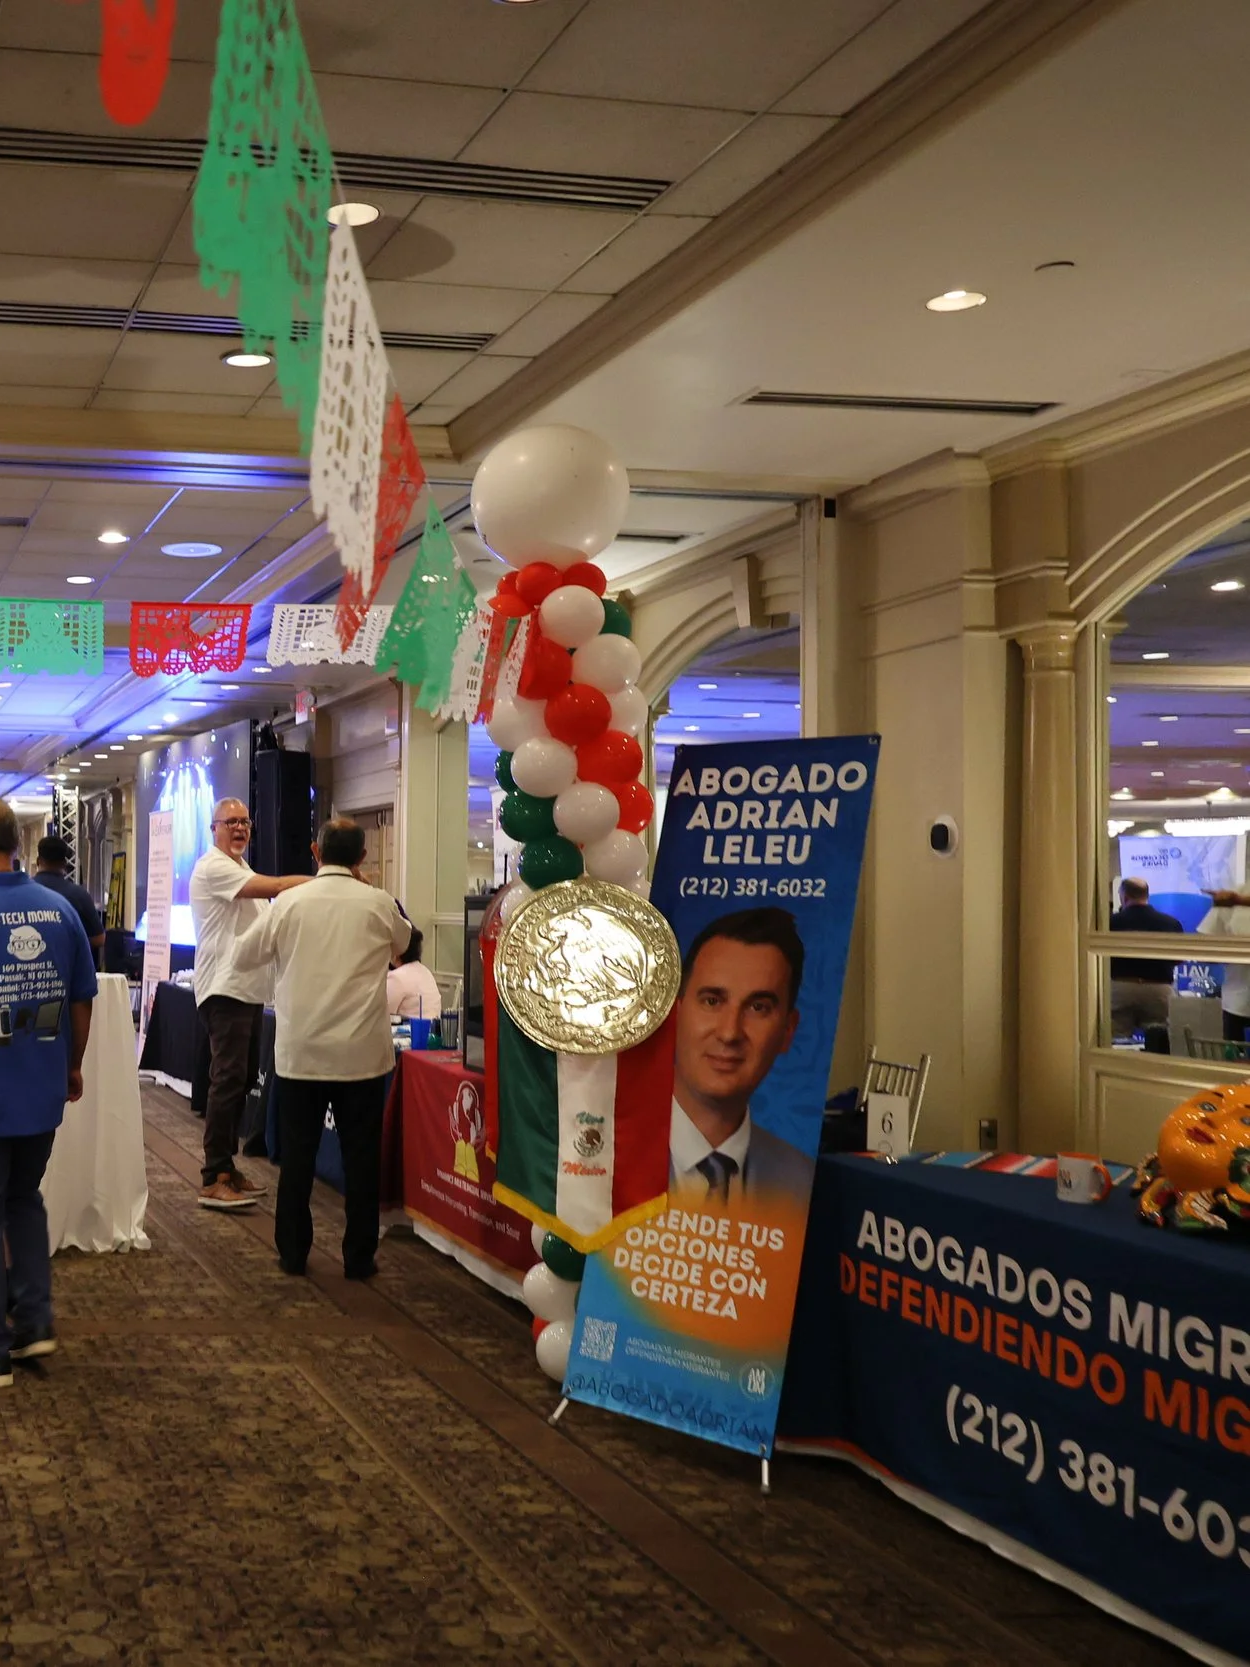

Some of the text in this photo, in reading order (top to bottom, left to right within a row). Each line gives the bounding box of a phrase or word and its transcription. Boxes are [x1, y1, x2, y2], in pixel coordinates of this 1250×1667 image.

[673, 760, 868, 797] ABOGADO
[686, 798, 839, 830] ADRIAN
[703, 834, 812, 865] LELEU
[679, 877, 826, 898] (212) 381-6032
[0, 911, 25, 924] TECH
[881, 1110, 893, 1136] 6
[625, 1226, 761, 1274] OPCIONES,
[738, 1221, 784, 1251] TUS
[613, 1246, 768, 1300] DECIDE CON
[856, 1209, 1092, 1331] ABOGADOS
[630, 1276, 738, 1320] CERTEZA
[840, 1252, 1126, 1406] DEFENDIENDO
[946, 1384, 1045, 1484] (212)
